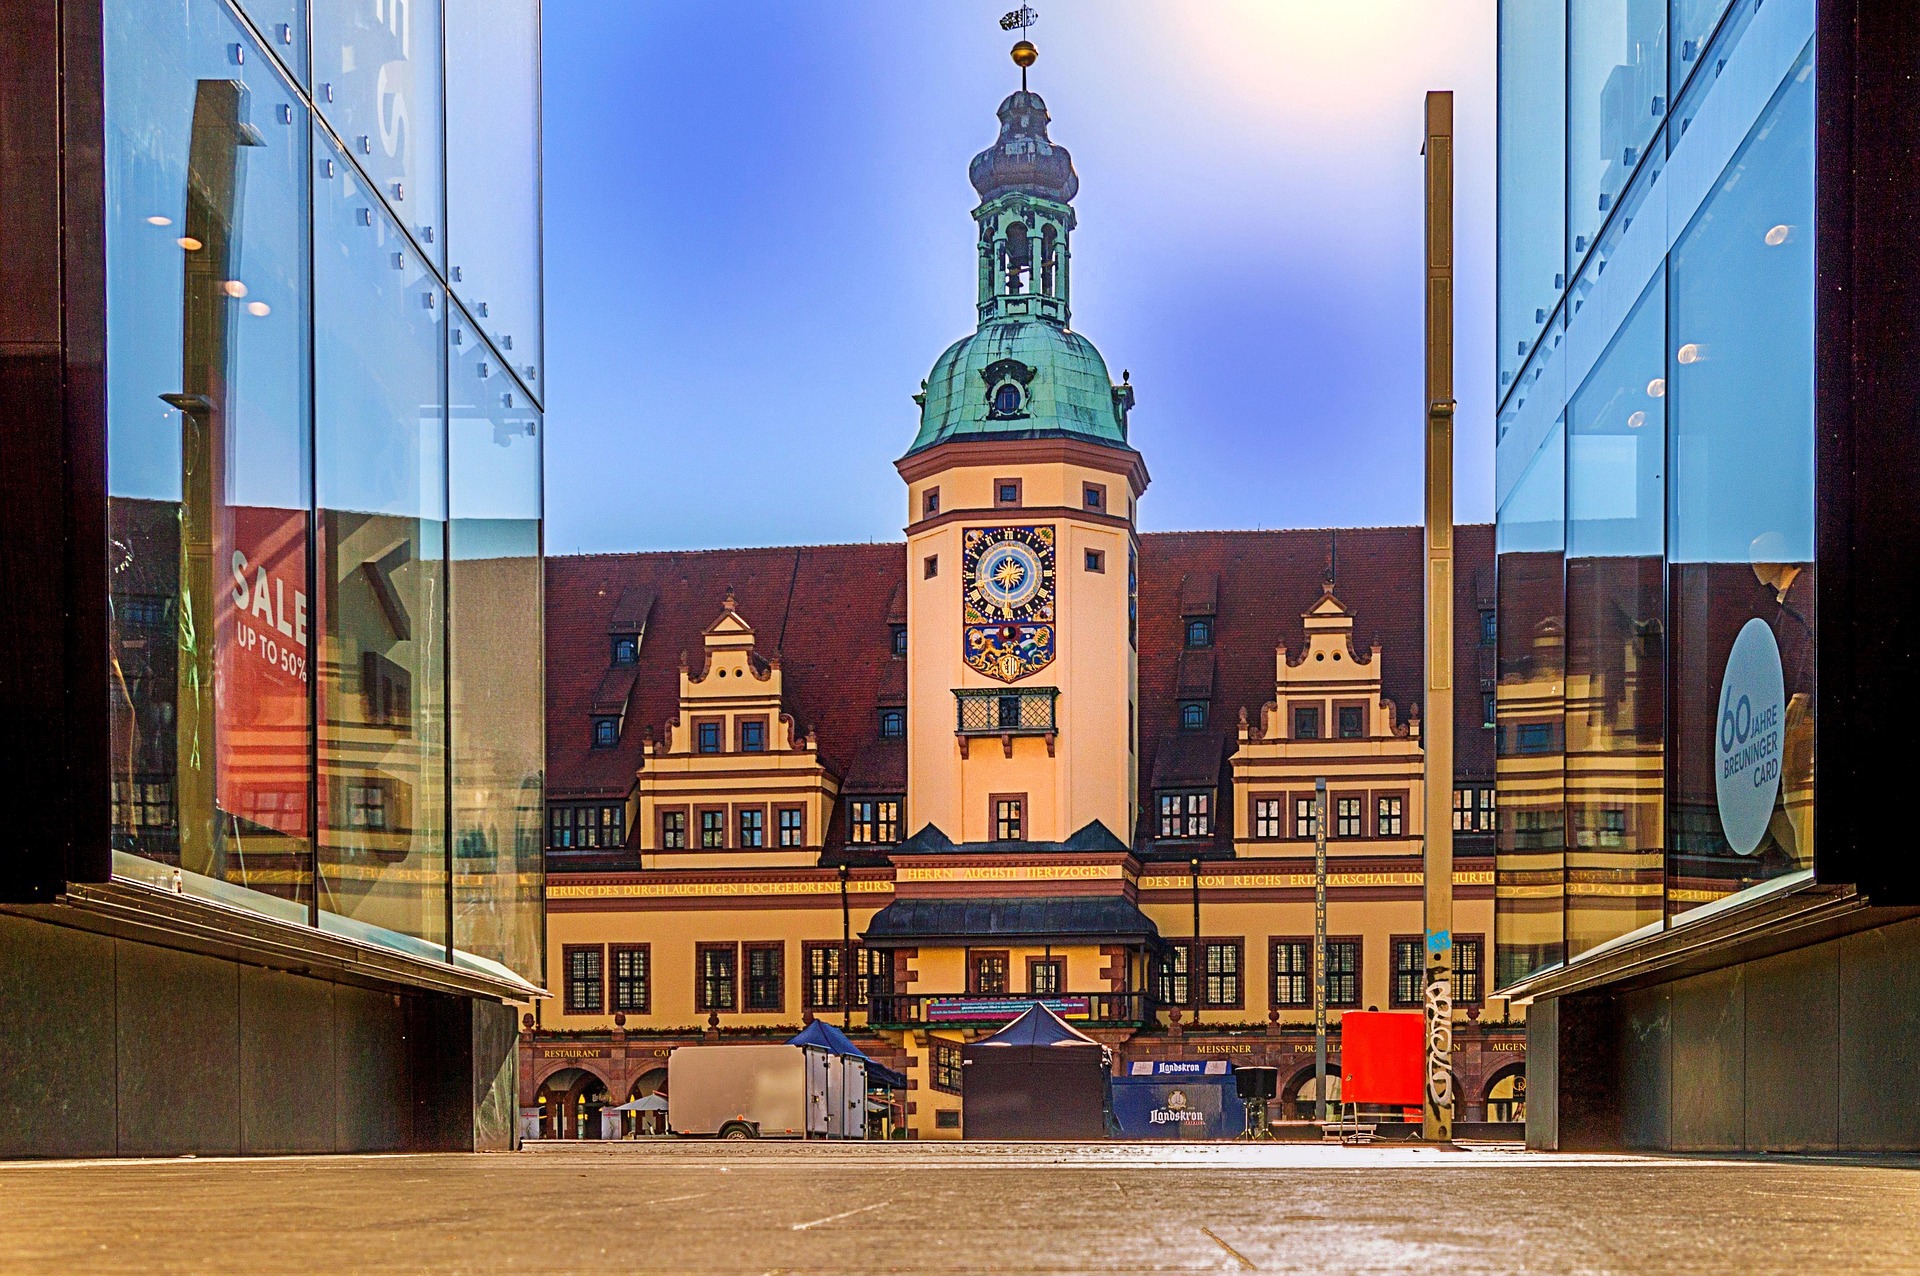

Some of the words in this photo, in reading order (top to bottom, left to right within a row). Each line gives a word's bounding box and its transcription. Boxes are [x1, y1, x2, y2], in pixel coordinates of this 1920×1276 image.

[232, 549, 306, 647] SALE
[238, 621, 256, 651] UP
[259, 634, 277, 664] TO
[281, 647, 306, 682] 50%
[1721, 684, 1750, 753] 60
[1750, 704, 1777, 739] JAHRE
[1724, 731, 1778, 779] BREUNINGER
[1753, 758, 1778, 787] CARD
[907, 869, 953, 879] HERRN
[964, 868, 1016, 879] AUGUSTI
[1026, 866, 1109, 878] HERTZOGEN
[1146, 877, 1169, 887] DES
[1233, 876, 1281, 886] REICHS
[598, 886, 619, 896] DES
[624, 884, 738, 896] DURCHLAUCHTIGEN
[1316, 807, 1325, 978] STADTGESCHICHTLICHES
[1316, 985, 1325, 1036] MUSEUM
[544, 1050, 600, 1058] RESTAURANT
[1197, 1045, 1251, 1054] MEISSENER
[1158, 1062, 1200, 1074] Landskron
[1149, 1109, 1204, 1124] Landskron
